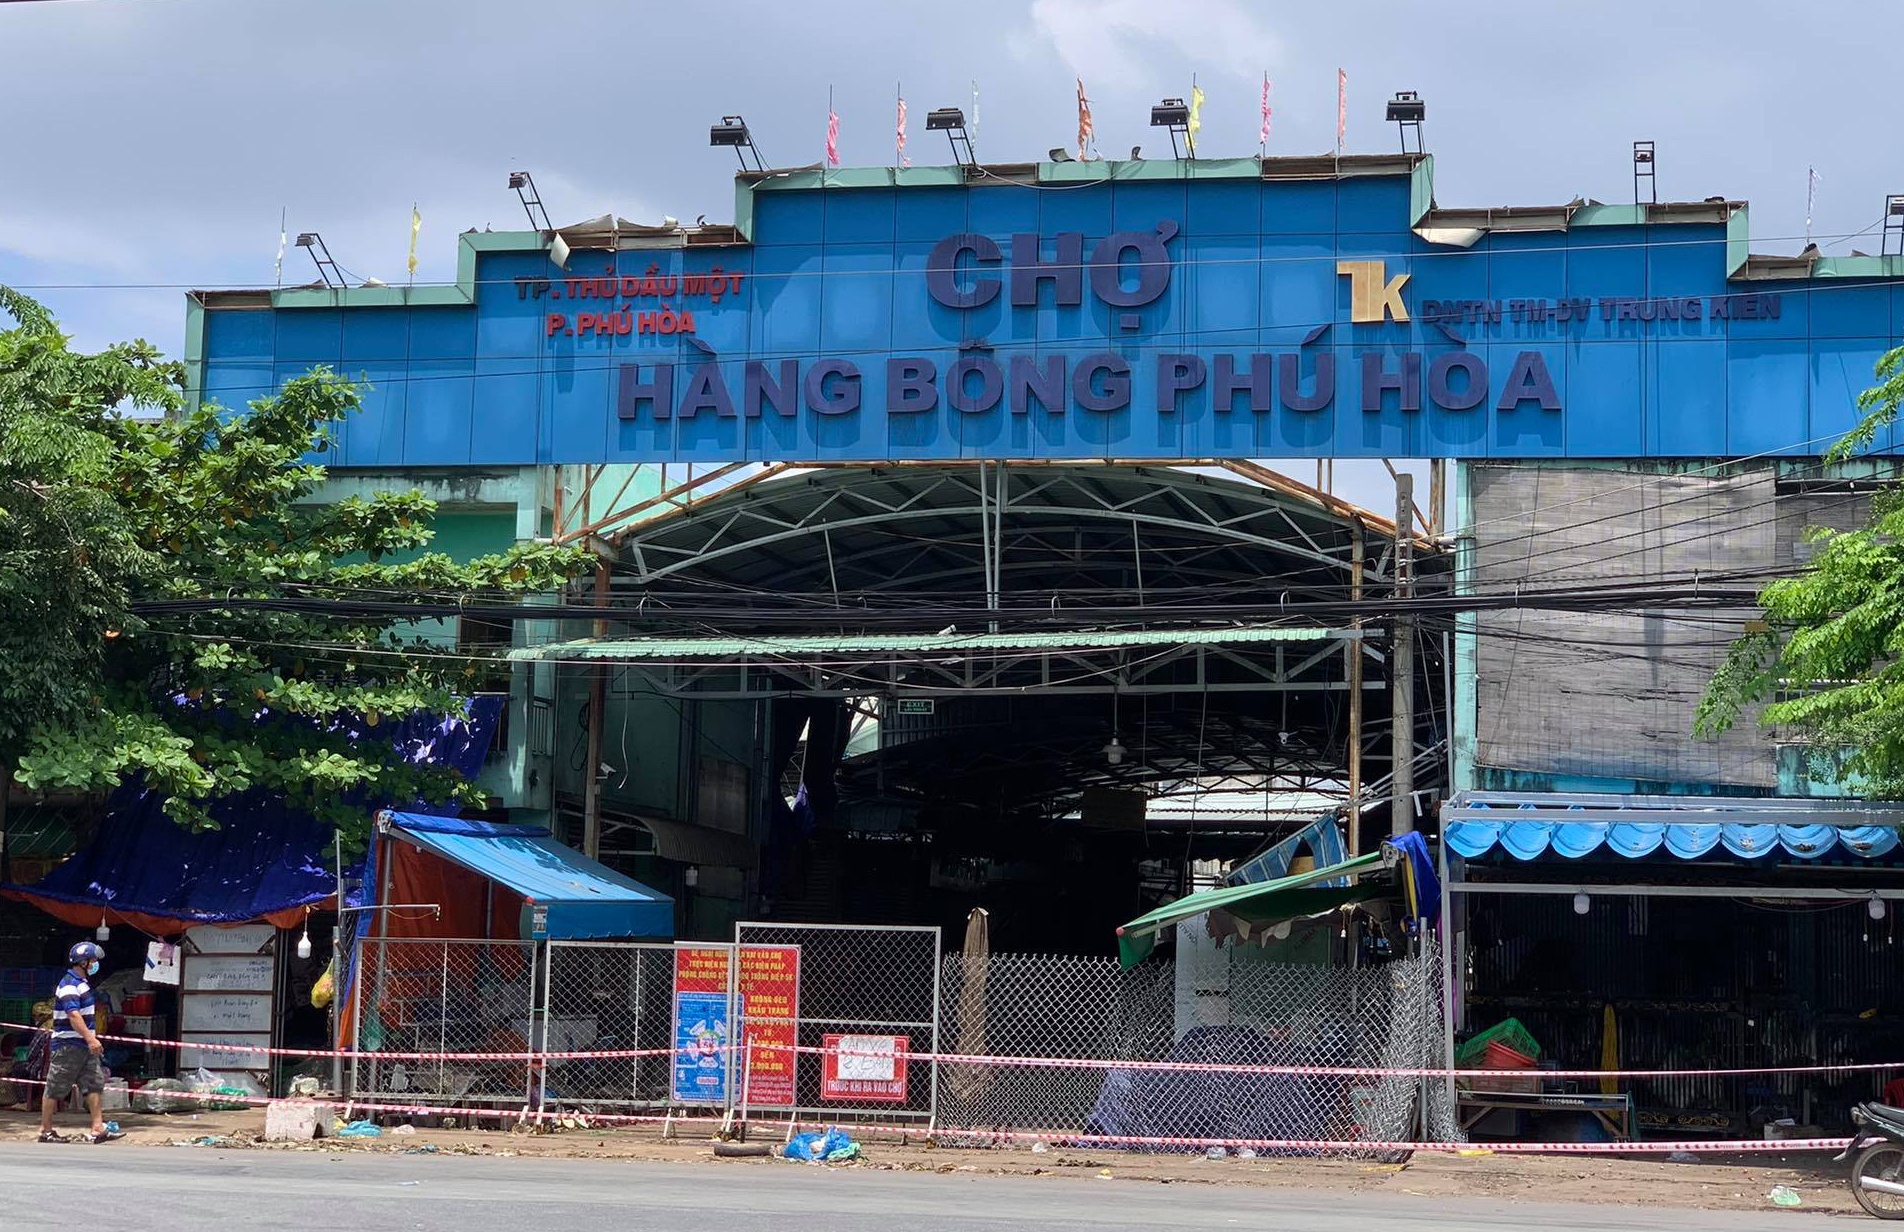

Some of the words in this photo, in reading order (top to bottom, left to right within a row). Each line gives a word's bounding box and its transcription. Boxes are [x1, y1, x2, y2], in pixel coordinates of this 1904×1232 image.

[514, 276, 561, 299] TP.
[564, 267, 617, 299] THỦ
[684, 266, 744, 304] MỘT
[926, 220, 1179, 329] CHỢ
[547, 313, 573, 336] P.
[577, 303, 632, 336] PHÚ
[638, 303, 695, 334] HÒA
[1422, 299, 1502, 324] DNTN
[1509, 297, 1590, 323] TM-DV
[1599, 294, 1700, 321] TRUNG
[618, 337, 862, 420] HÀNG
[1157, 323, 1334, 413] PHÚ
[1362, 322, 1562, 412] HÒA
